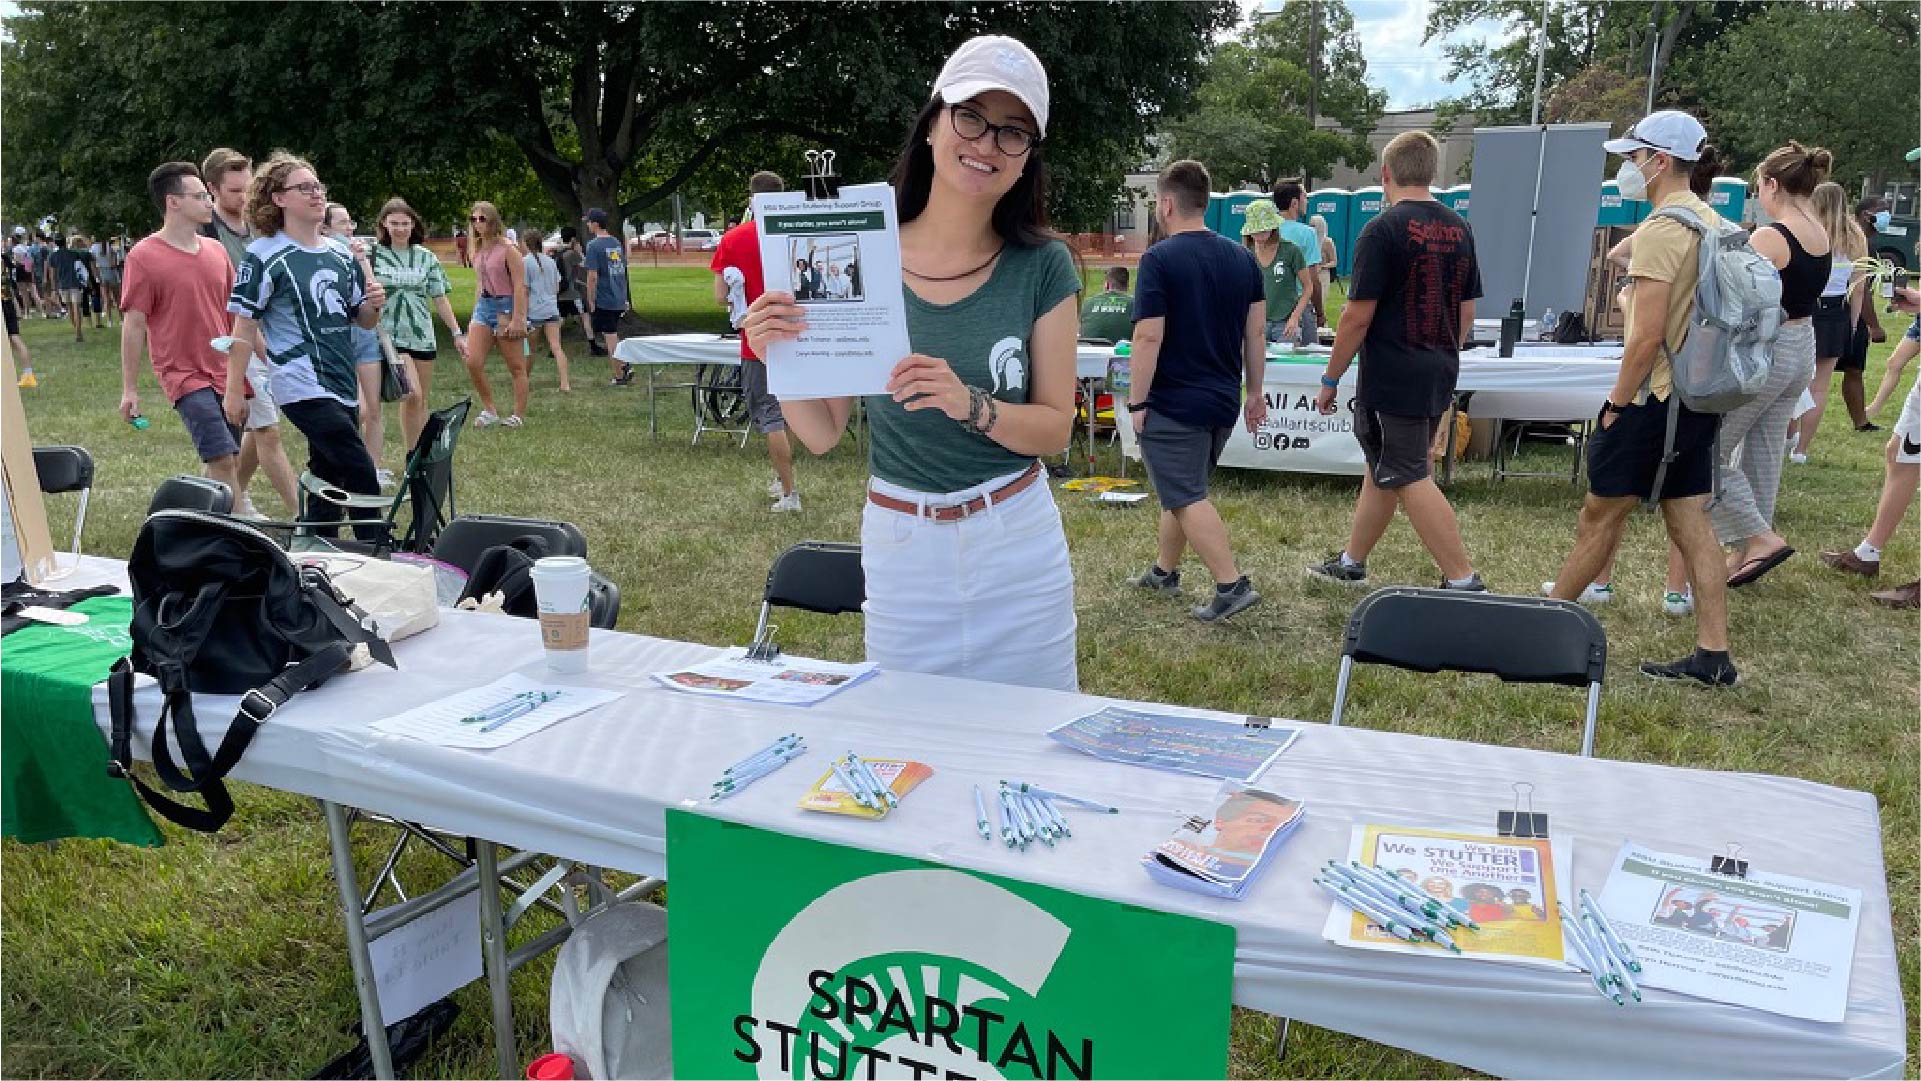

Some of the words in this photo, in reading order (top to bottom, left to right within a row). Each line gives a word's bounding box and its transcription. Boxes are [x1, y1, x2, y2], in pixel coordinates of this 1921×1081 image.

[1293, 393, 1338, 413] Ars
[1383, 842, 1416, 855] We
[1423, 846, 1518, 867] STUTTER
[1459, 859, 1518, 873] Support
[808, 969, 1093, 1080] SPARTAN
[733, 1014, 977, 1080] STUTT
